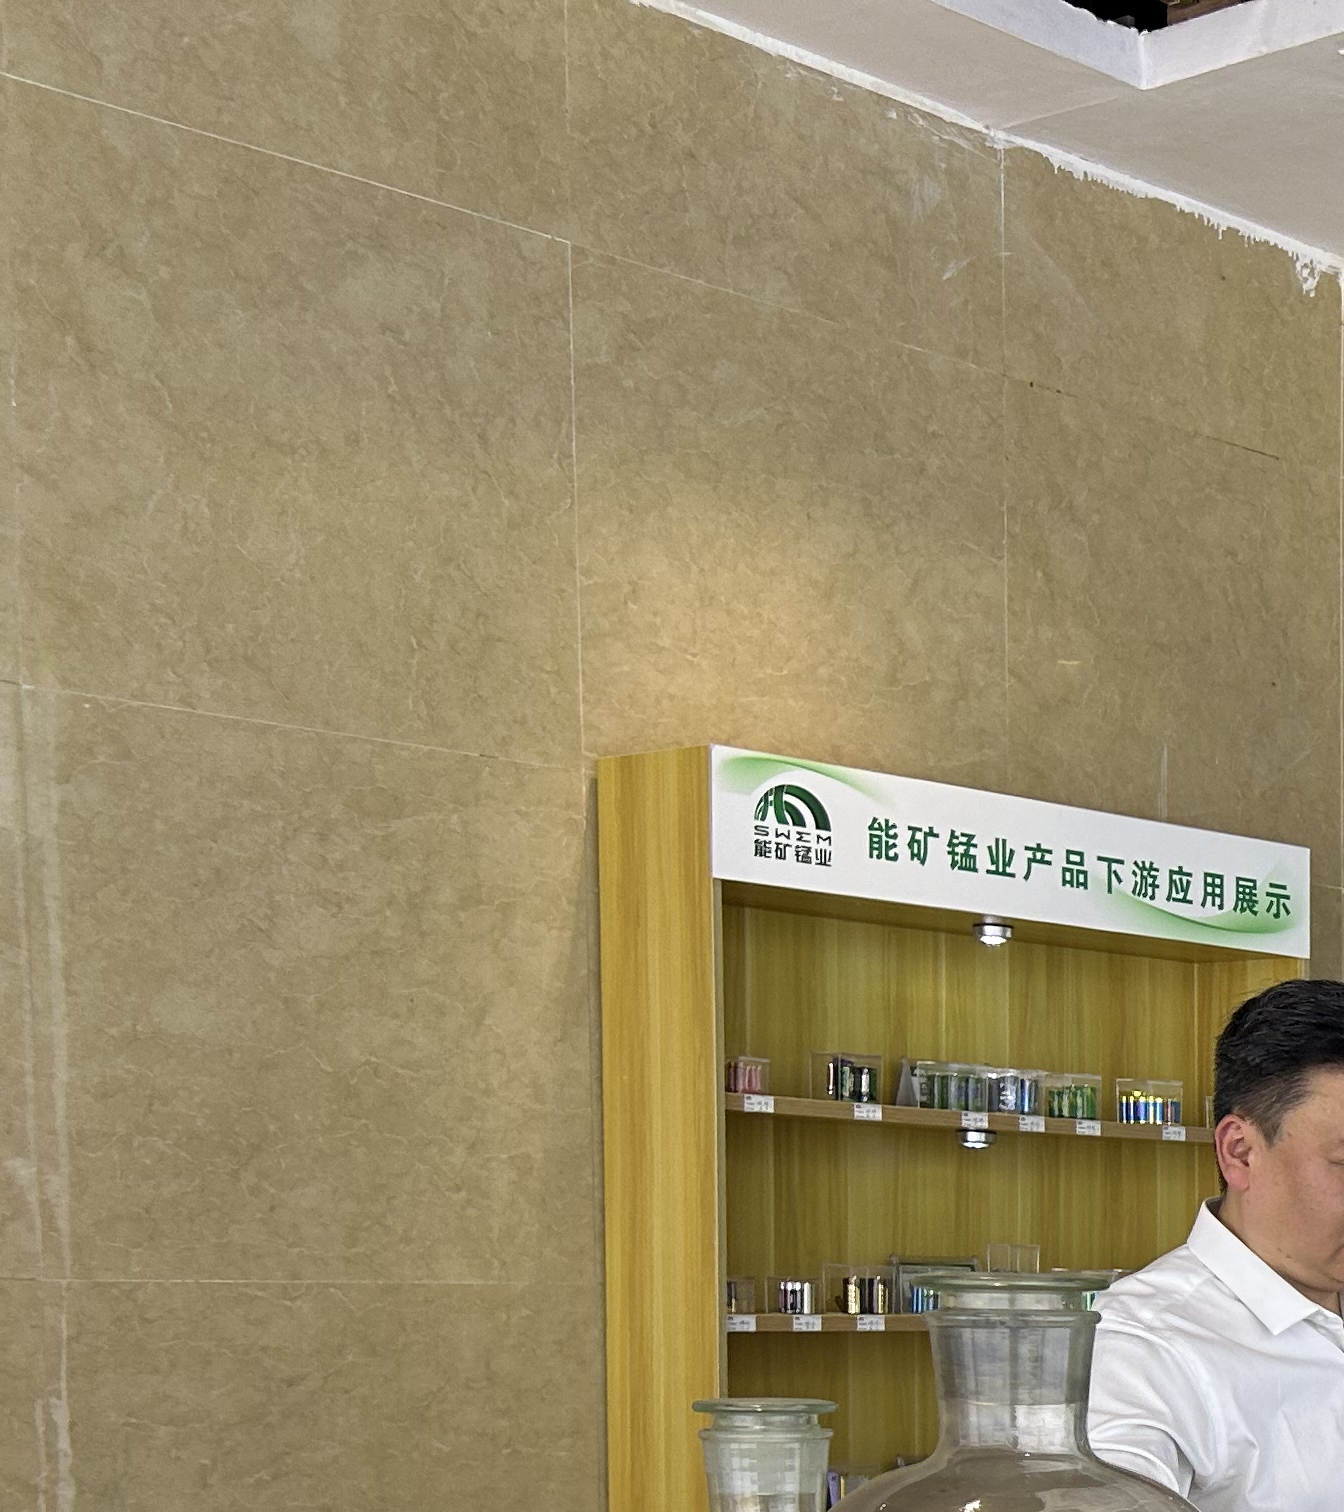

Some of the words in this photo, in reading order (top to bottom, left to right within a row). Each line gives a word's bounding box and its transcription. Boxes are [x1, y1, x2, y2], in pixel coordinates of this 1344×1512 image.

[753, 838, 833, 868] 能矿锰业
[867, 815, 1292, 920] 能矿锰业产品下游应用展示
